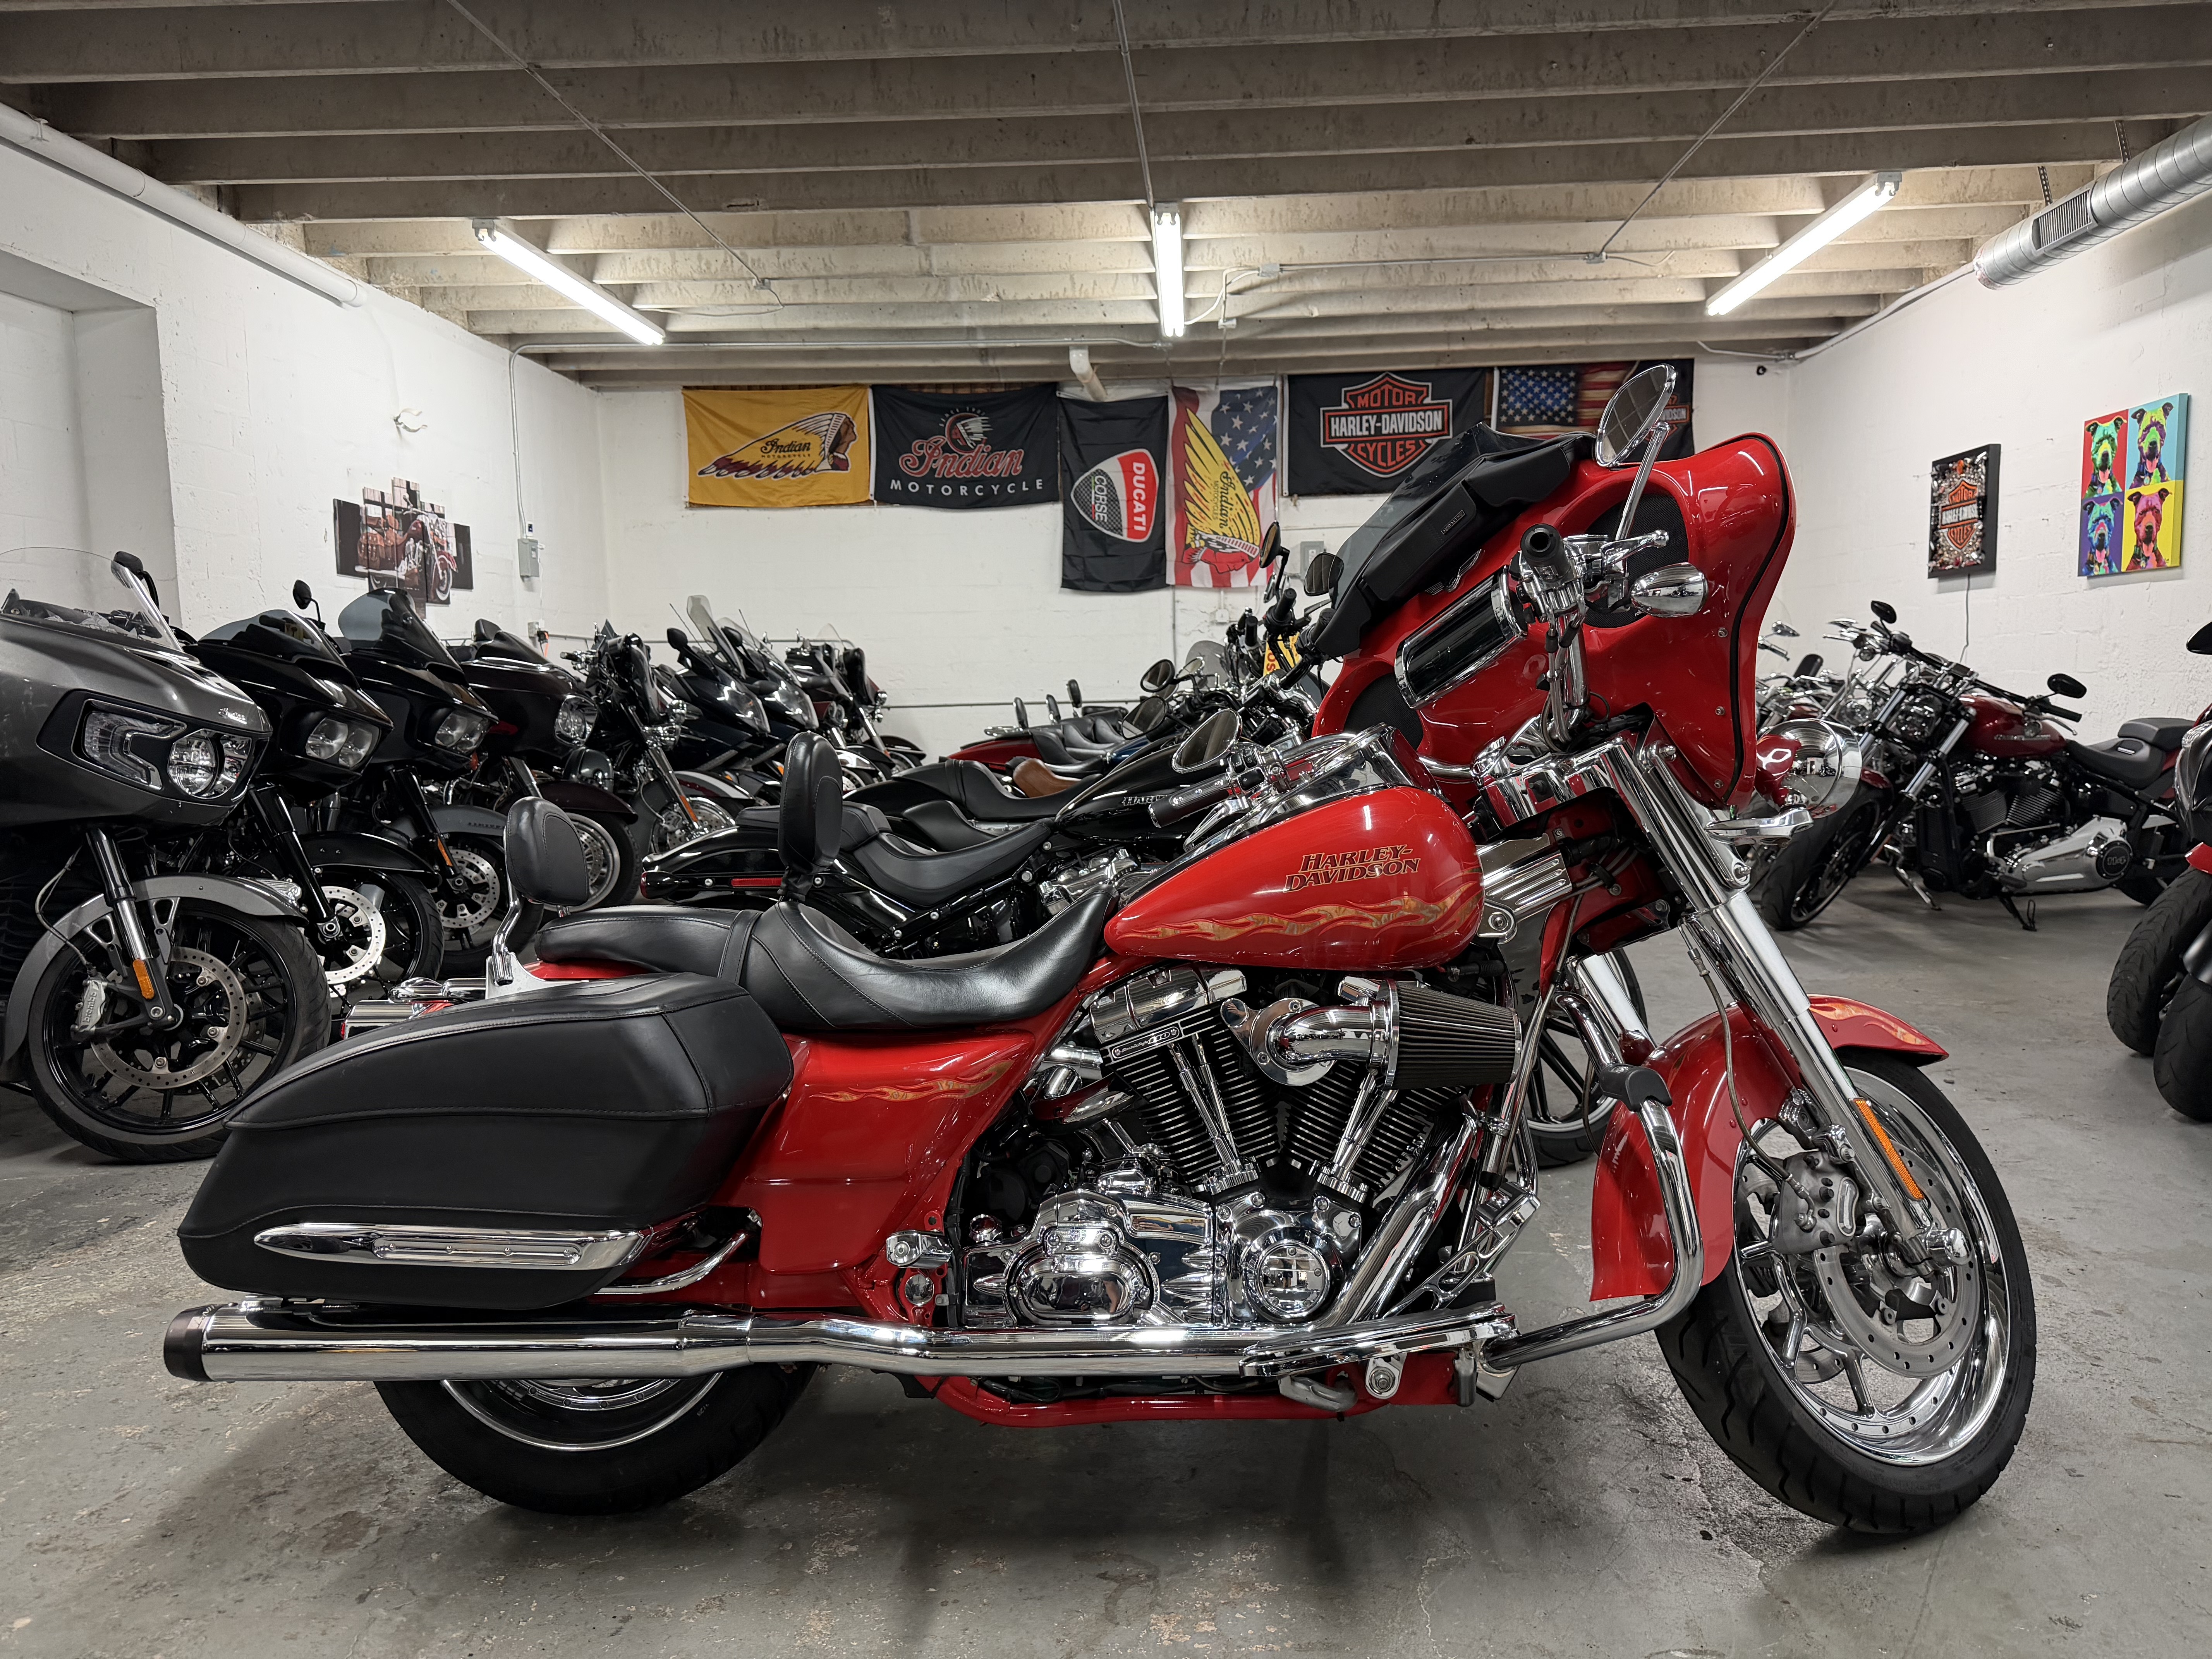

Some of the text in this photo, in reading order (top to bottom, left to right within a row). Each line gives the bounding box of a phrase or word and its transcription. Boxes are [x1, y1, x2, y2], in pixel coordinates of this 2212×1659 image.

[1357, 384, 1416, 408] MOTOR
[1330, 410, 1443, 437] HARLEY-DAVIDSON
[760, 438, 811, 454] Indian
[899, 435, 1024, 478] Indian
[1357, 440, 1416, 467] CYCLES
[890, 479, 1043, 496] MOTORCYCLE
[1094, 475, 1108, 522] CORSE
[1133, 462, 1146, 531] DUCATI
[1219, 471, 1236, 529] Indian
[1121, 794, 1168, 805] HARL
[1298, 844, 1413, 873] HARLEY-
[1283, 858, 1421, 893] DAVIDSON
[82, 991, 97, 1023] brembo
